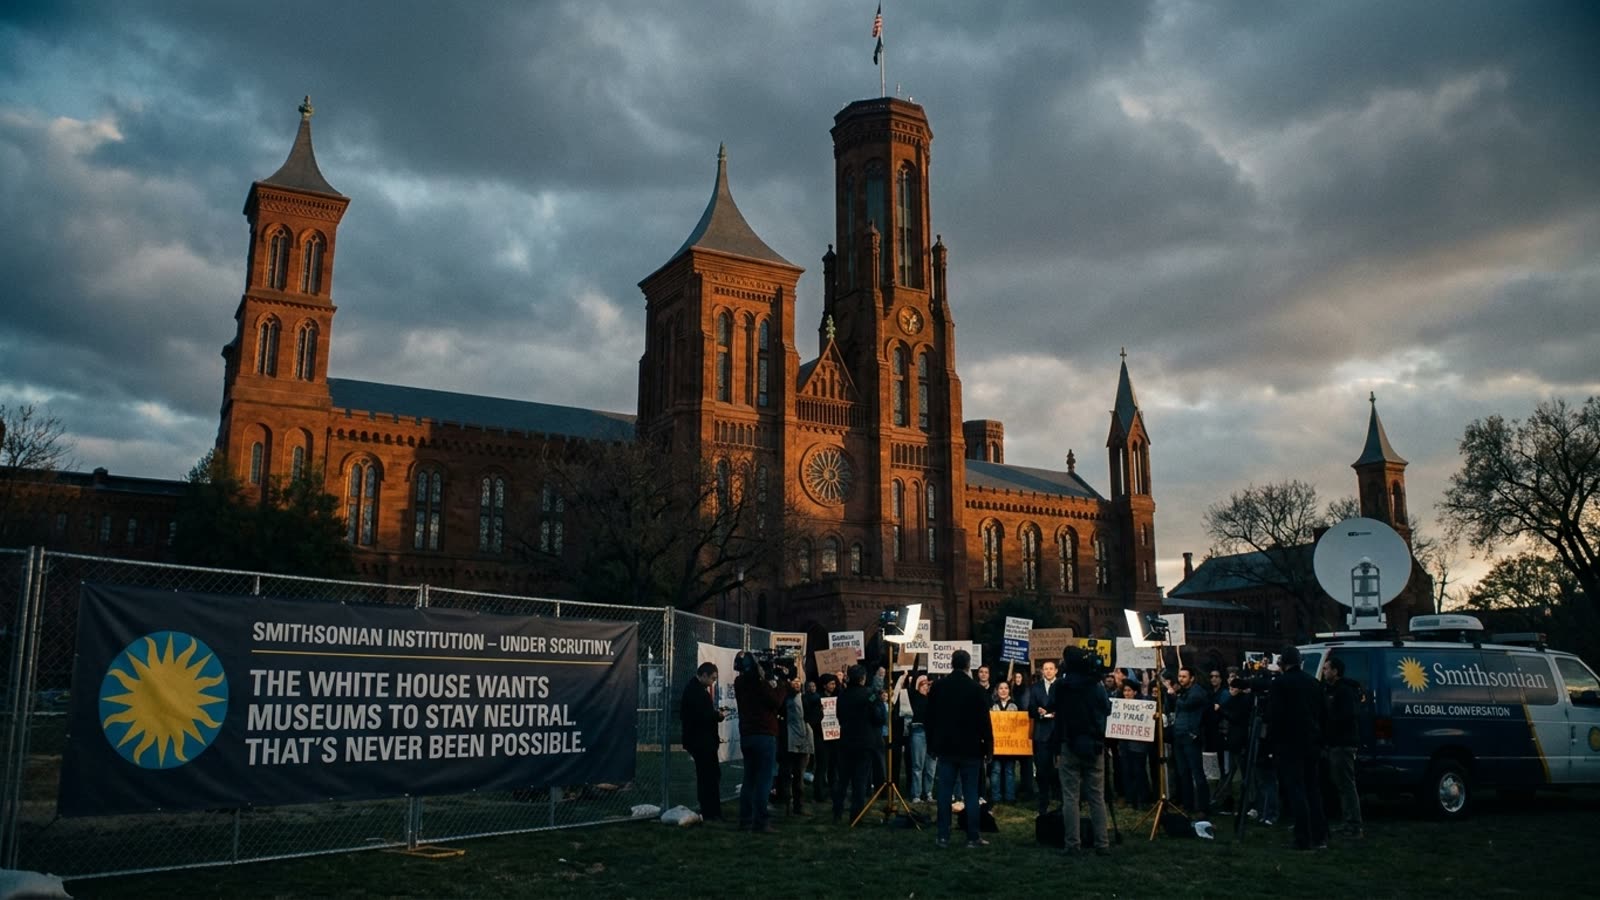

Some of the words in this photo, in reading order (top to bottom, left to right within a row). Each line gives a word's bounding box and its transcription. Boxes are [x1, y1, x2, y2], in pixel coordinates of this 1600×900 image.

[252, 621, 383, 647] SMITHSONIAN
[387, 629, 485, 650] INSTITUTION
[500, 635, 547, 653] UNDER
[549, 637, 615, 656] SCRUTINY.
[250, 669, 302, 697] THE
[308, 671, 390, 698] WHITE
[396, 673, 471, 698] HOUSE
[476, 675, 549, 698] WANTS
[1432, 662, 1549, 689] Smithsonian
[247, 703, 382, 731] MUSEUMS
[388, 704, 419, 729] TO
[425, 704, 479, 728] STAY
[484, 704, 576, 728] NEUTRAL.
[1404, 704, 1412, 715] A
[1413, 704, 1446, 716] GLOBAL
[1448, 705, 1511, 717] CONVERSATION
[245, 736, 338, 766] THAT’S
[344, 735, 423, 762] NEVER
[429, 734, 485, 759] BEEN
[491, 731, 587, 757] POSSIBLE.
